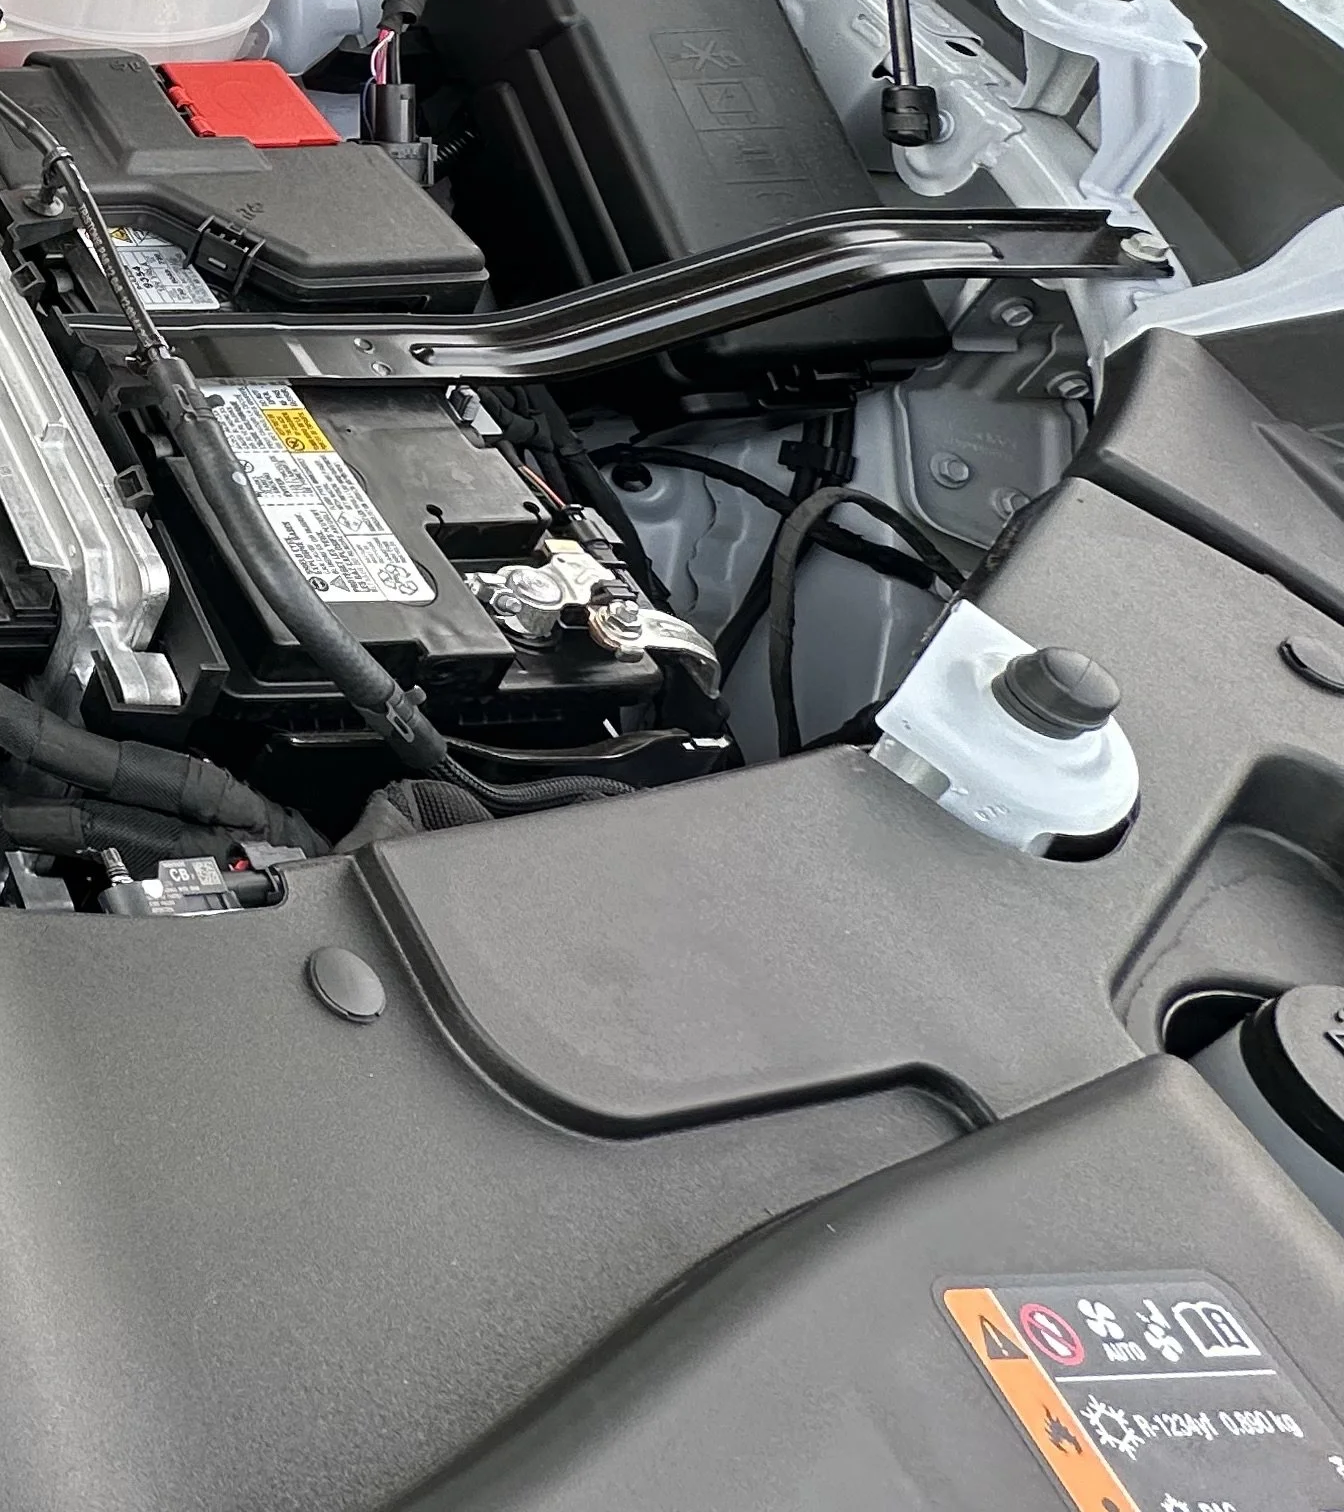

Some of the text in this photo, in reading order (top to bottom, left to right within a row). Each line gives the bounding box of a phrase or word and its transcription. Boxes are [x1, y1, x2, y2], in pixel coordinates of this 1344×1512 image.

[1102, 1341, 1147, 1362] AUTO
[1133, 1412, 1219, 1441] R-1234yf
[1267, 1410, 1304, 1438] kg
